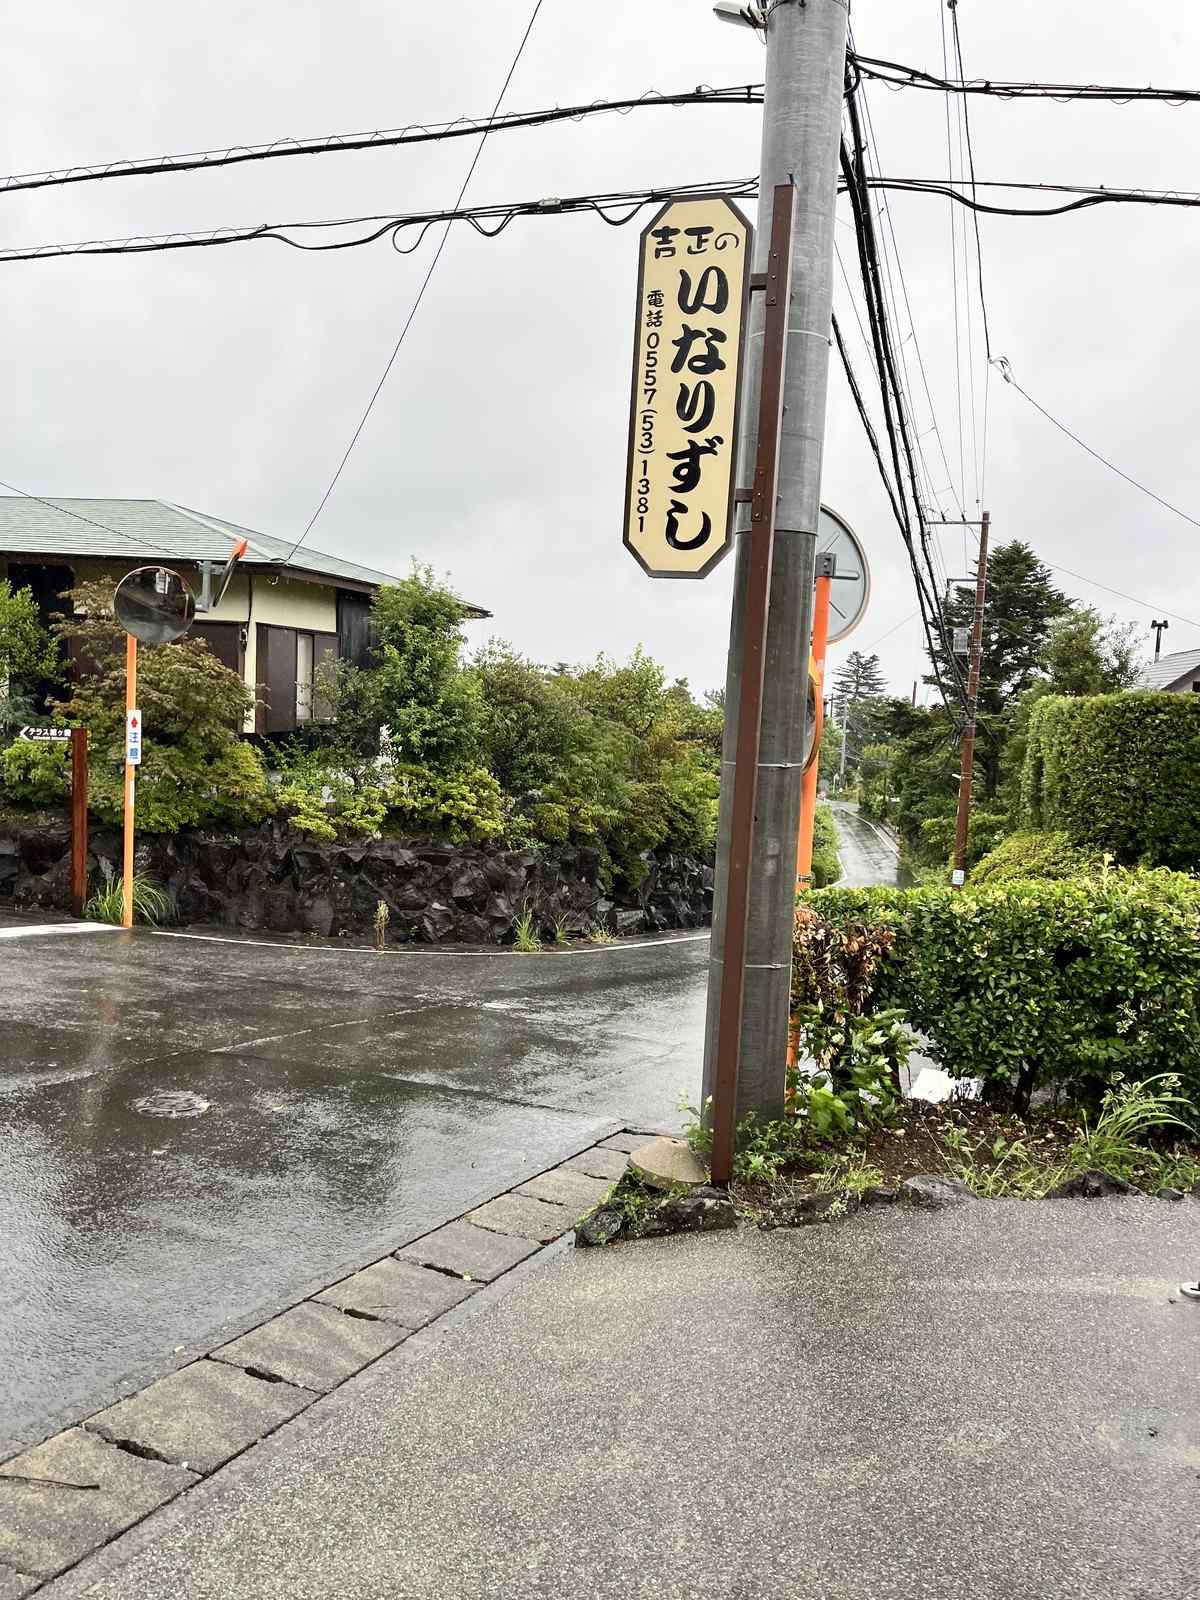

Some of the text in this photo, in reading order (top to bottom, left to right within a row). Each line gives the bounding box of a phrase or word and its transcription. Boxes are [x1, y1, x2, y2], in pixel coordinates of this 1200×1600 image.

[651, 226, 739, 259] 吉正の
[665, 265, 729, 551] いなりずし
